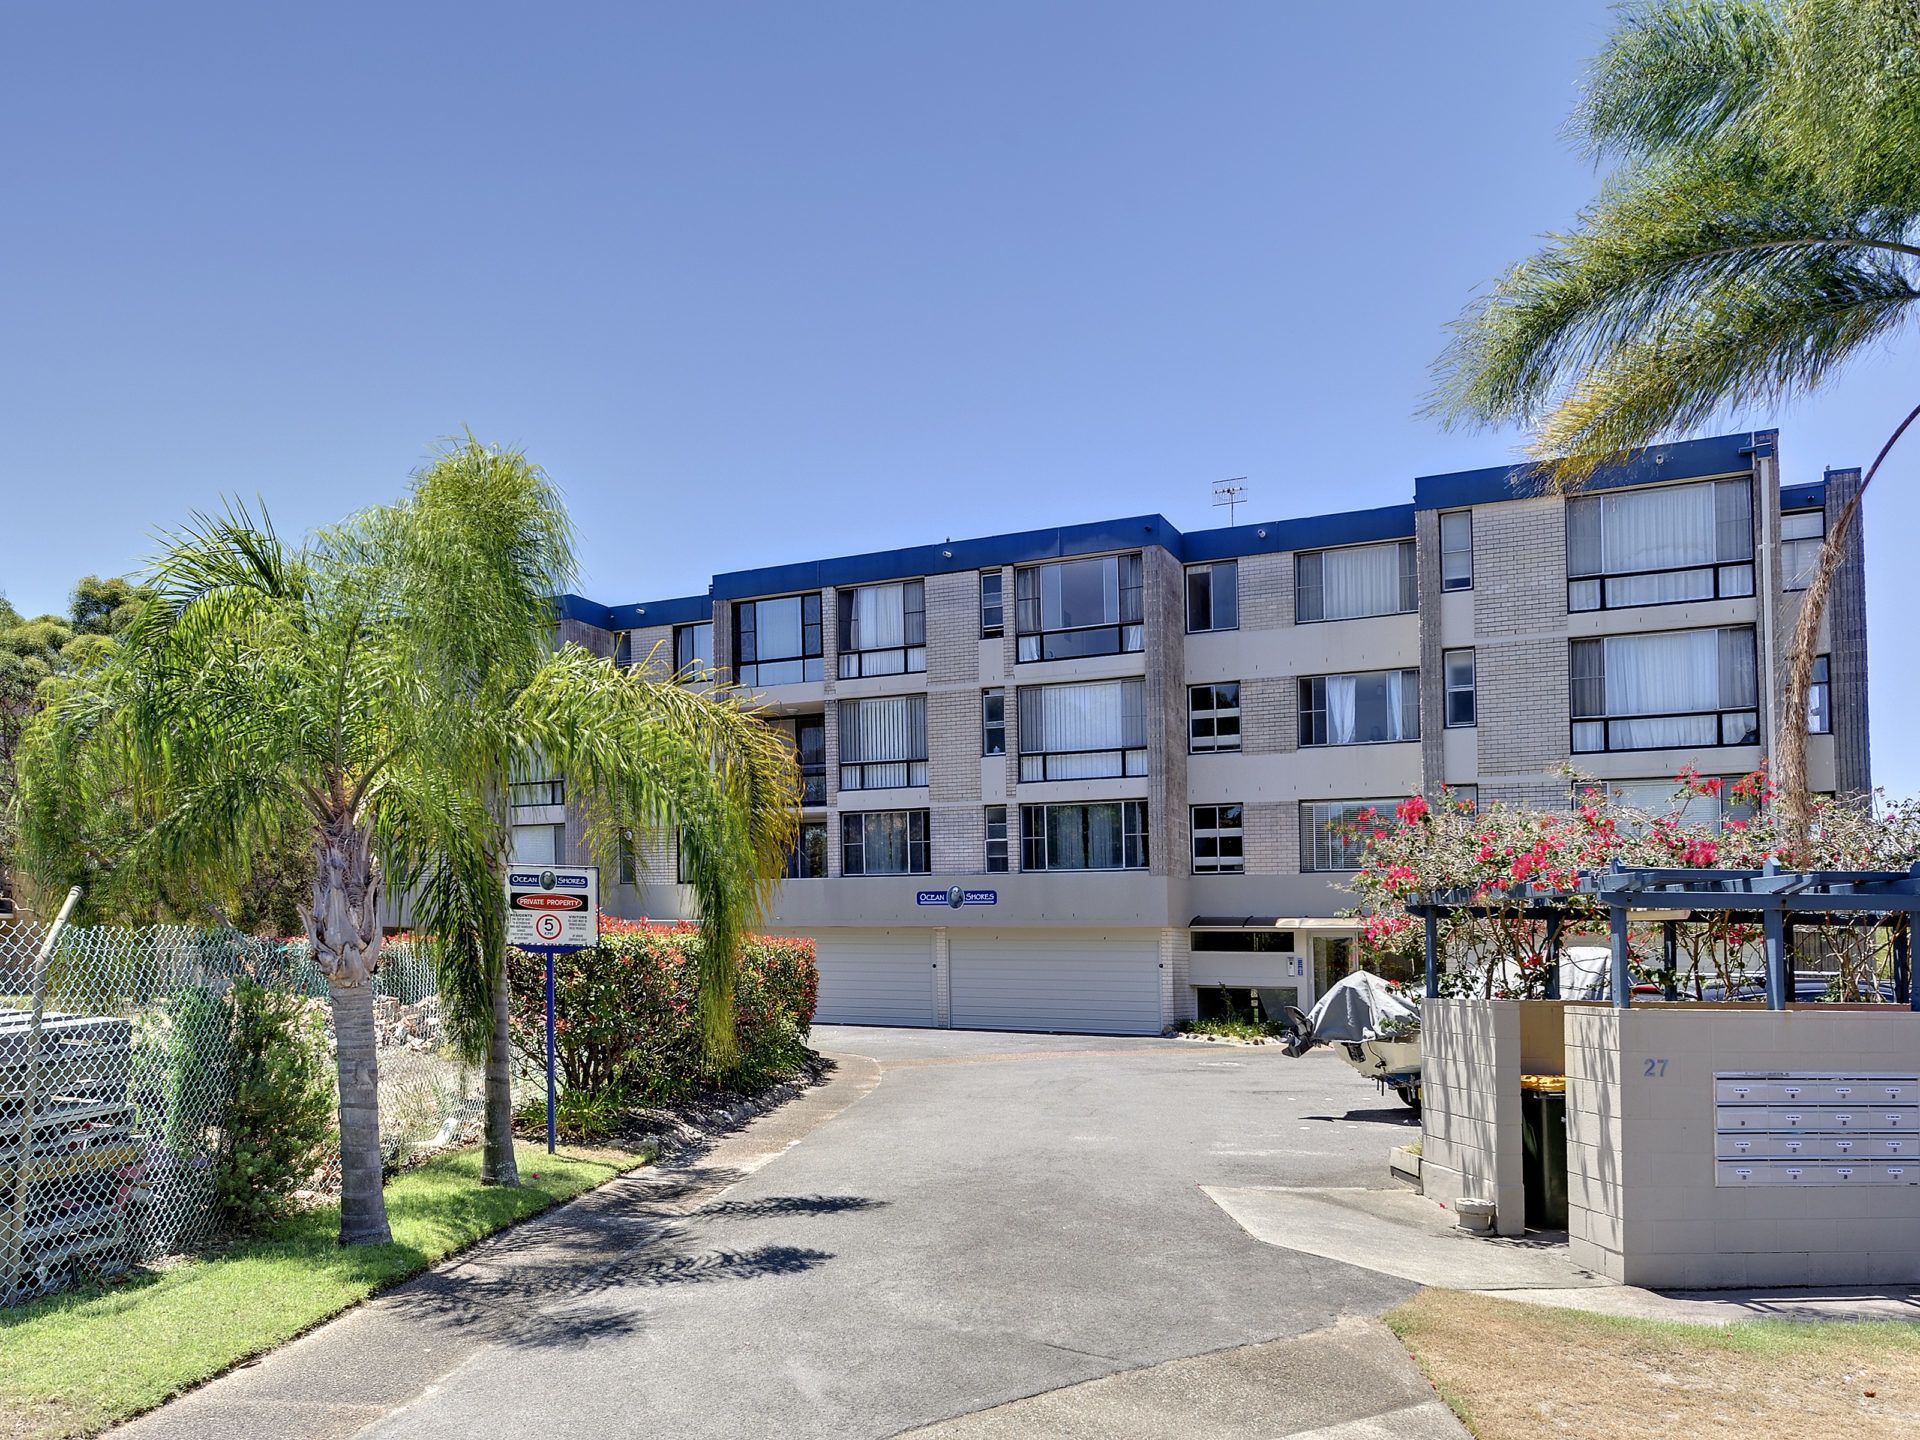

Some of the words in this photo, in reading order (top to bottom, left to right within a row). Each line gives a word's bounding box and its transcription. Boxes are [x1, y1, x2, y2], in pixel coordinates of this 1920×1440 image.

[557, 877, 586, 885] SHORES
[919, 893, 945, 901] OCEAN
[965, 893, 995, 901] SHORES
[546, 898, 579, 906] PROPERTY
[544, 918, 554, 932] 5
[1643, 1058, 1669, 1077] 27
